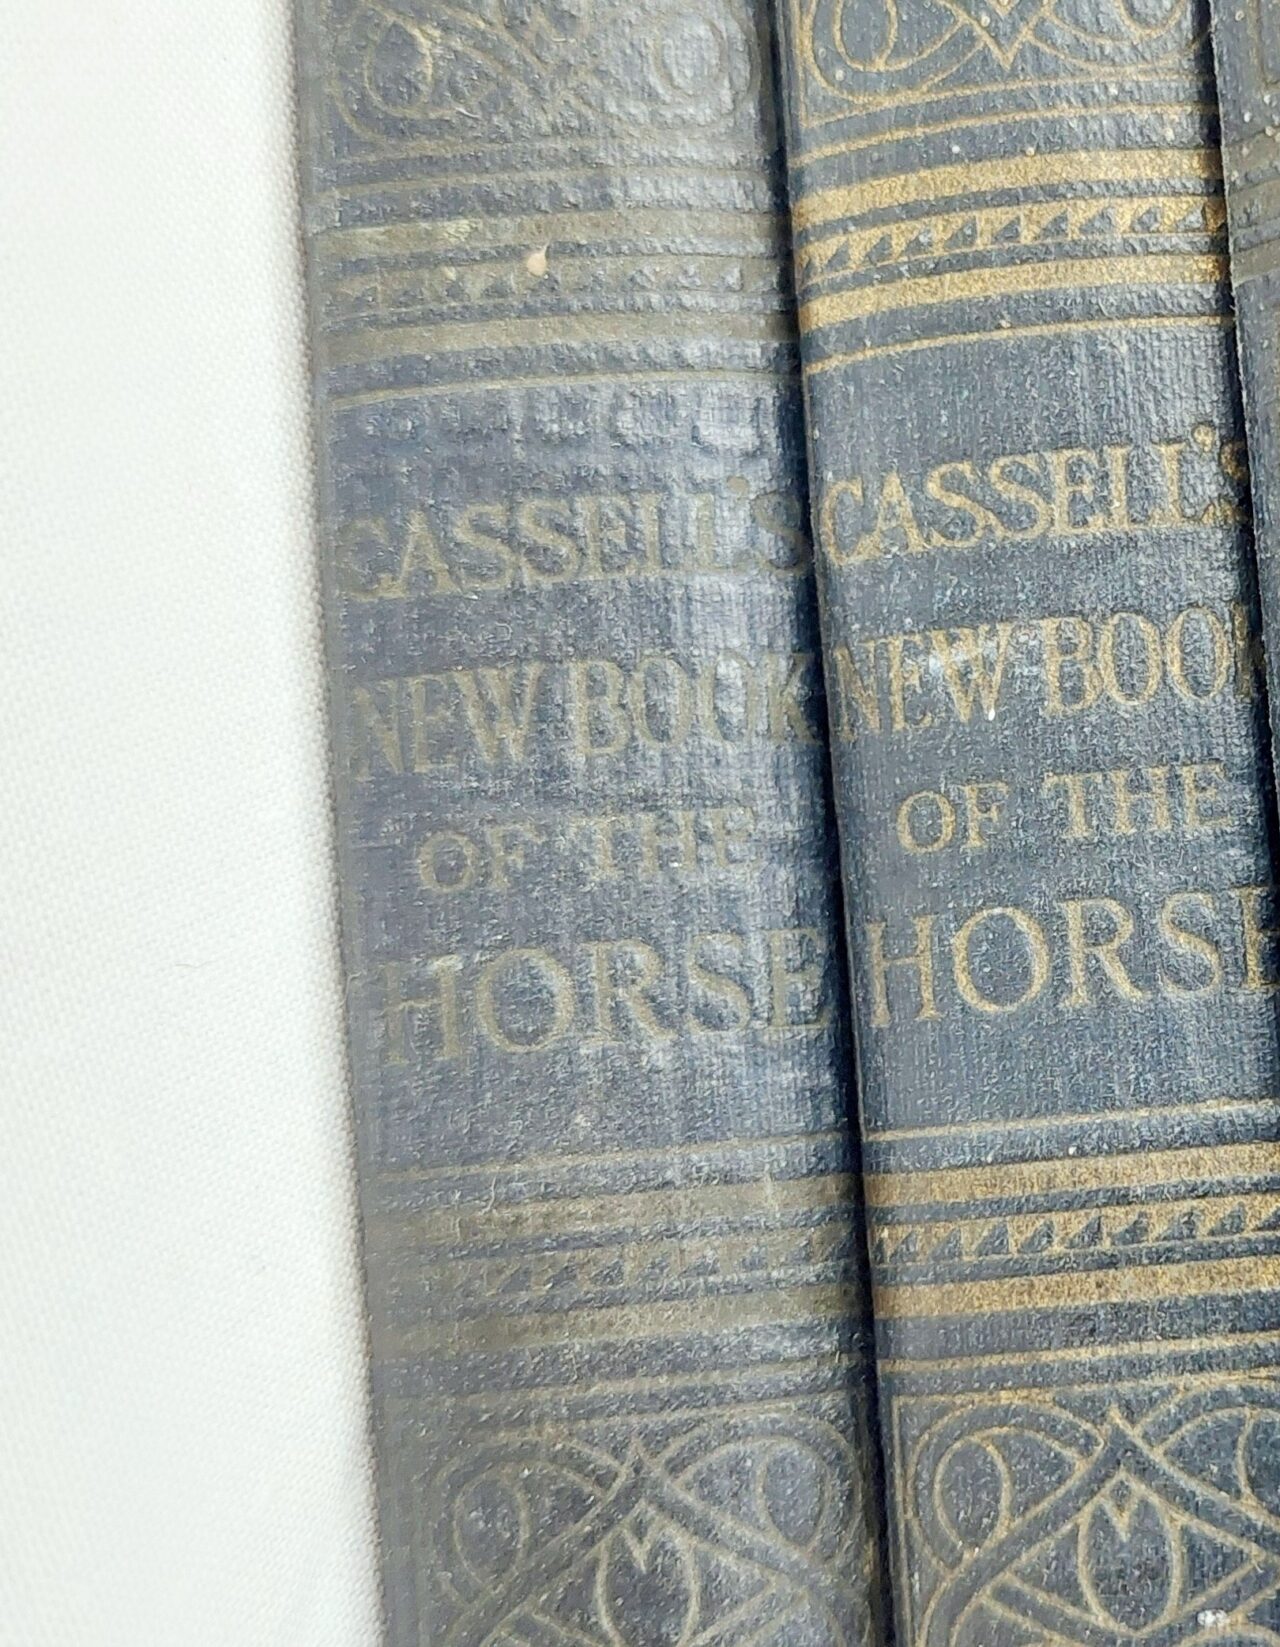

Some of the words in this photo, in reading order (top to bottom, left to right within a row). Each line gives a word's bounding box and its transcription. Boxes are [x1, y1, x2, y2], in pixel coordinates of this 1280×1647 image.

[350, 659, 545, 782] NEW
[567, 650, 823, 759] BOOK
[833, 626, 1010, 742] NEW
[419, 822, 540, 893] OF
[586, 807, 757, 878] THE
[900, 782, 1007, 853] OF
[1043, 763, 1237, 842] THE
[377, 929, 833, 1063] HORSE
